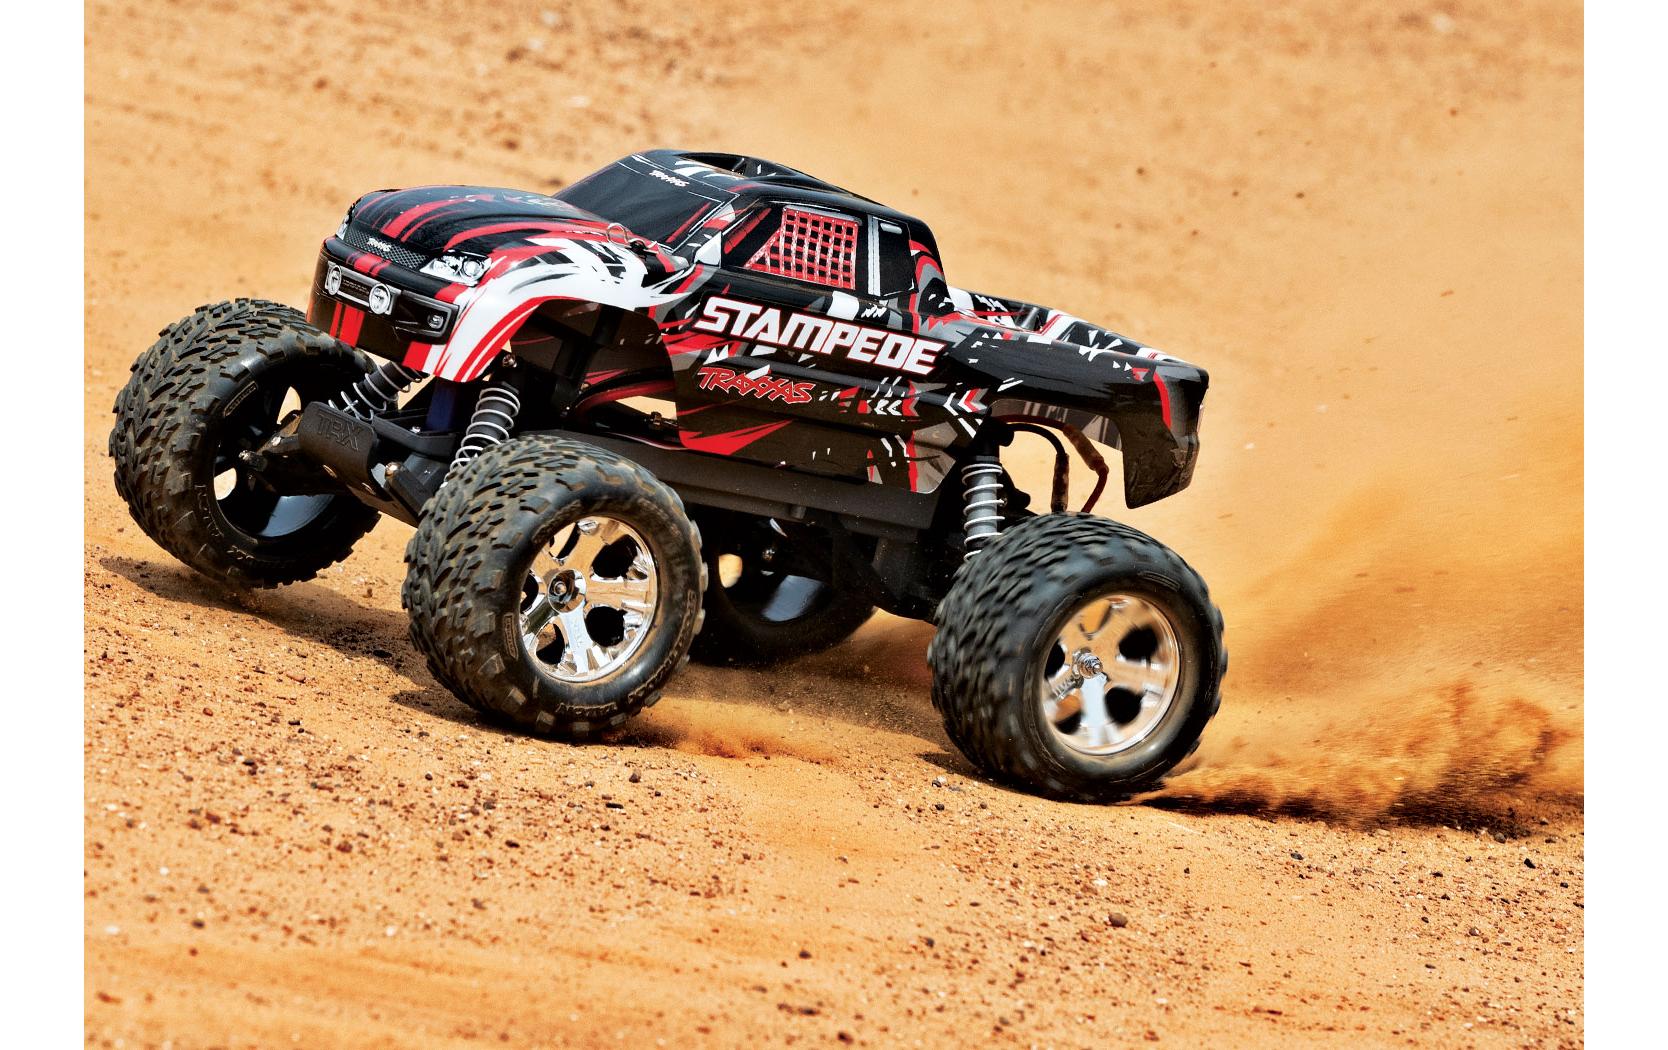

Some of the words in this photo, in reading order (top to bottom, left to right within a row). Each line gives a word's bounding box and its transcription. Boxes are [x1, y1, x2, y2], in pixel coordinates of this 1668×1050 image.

[693, 296, 947, 376] STAMPEDE
[697, 366, 816, 404] TRAXXAS
[318, 413, 363, 452] TRX
